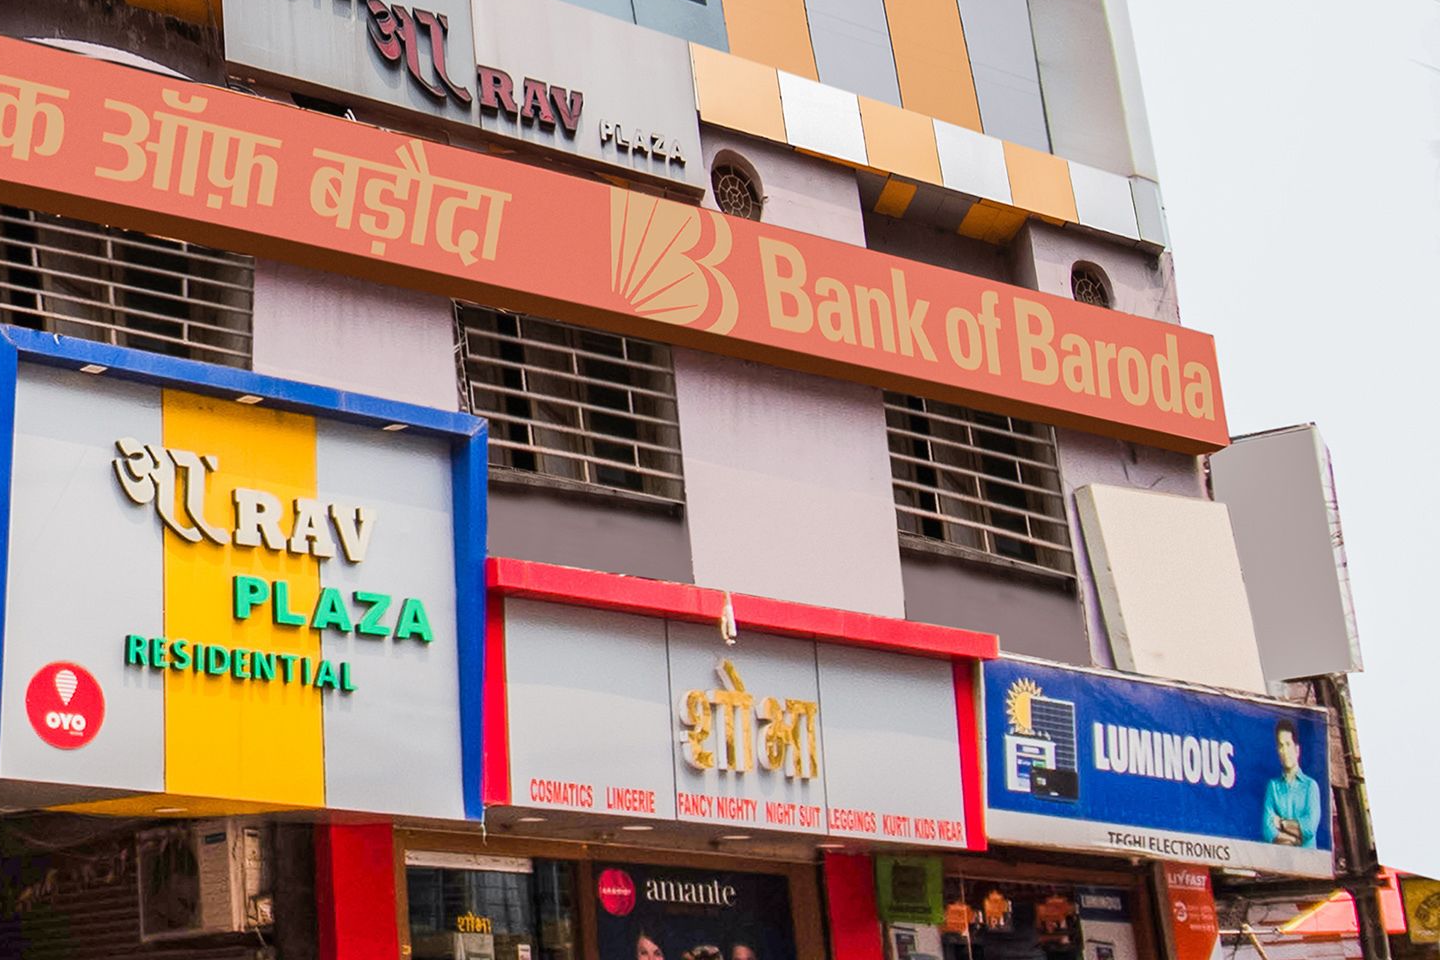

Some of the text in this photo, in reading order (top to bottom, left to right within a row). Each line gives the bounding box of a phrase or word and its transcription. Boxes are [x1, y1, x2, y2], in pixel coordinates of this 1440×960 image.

[599, 118, 686, 166] PLAZA
[309, 139, 513, 266] बड़ौदा
[758, 235, 1216, 422] Bank of Baroda
[233, 575, 434, 644] PLAZA
[125, 634, 358, 692] RESIDENTIAL
[45, 711, 86, 731] OYO
[679, 658, 818, 779] शोभा
[1093, 722, 1236, 789] LUMINOUS
[530, 778, 964, 842] COSMATICS LINGERIE FANCY NIGHTY NIGHT SUIT LEGGINGS KURTI KIDS WEAR
[1149, 837, 1231, 861] ELECTRONICS
[646, 879, 737, 907] amante
